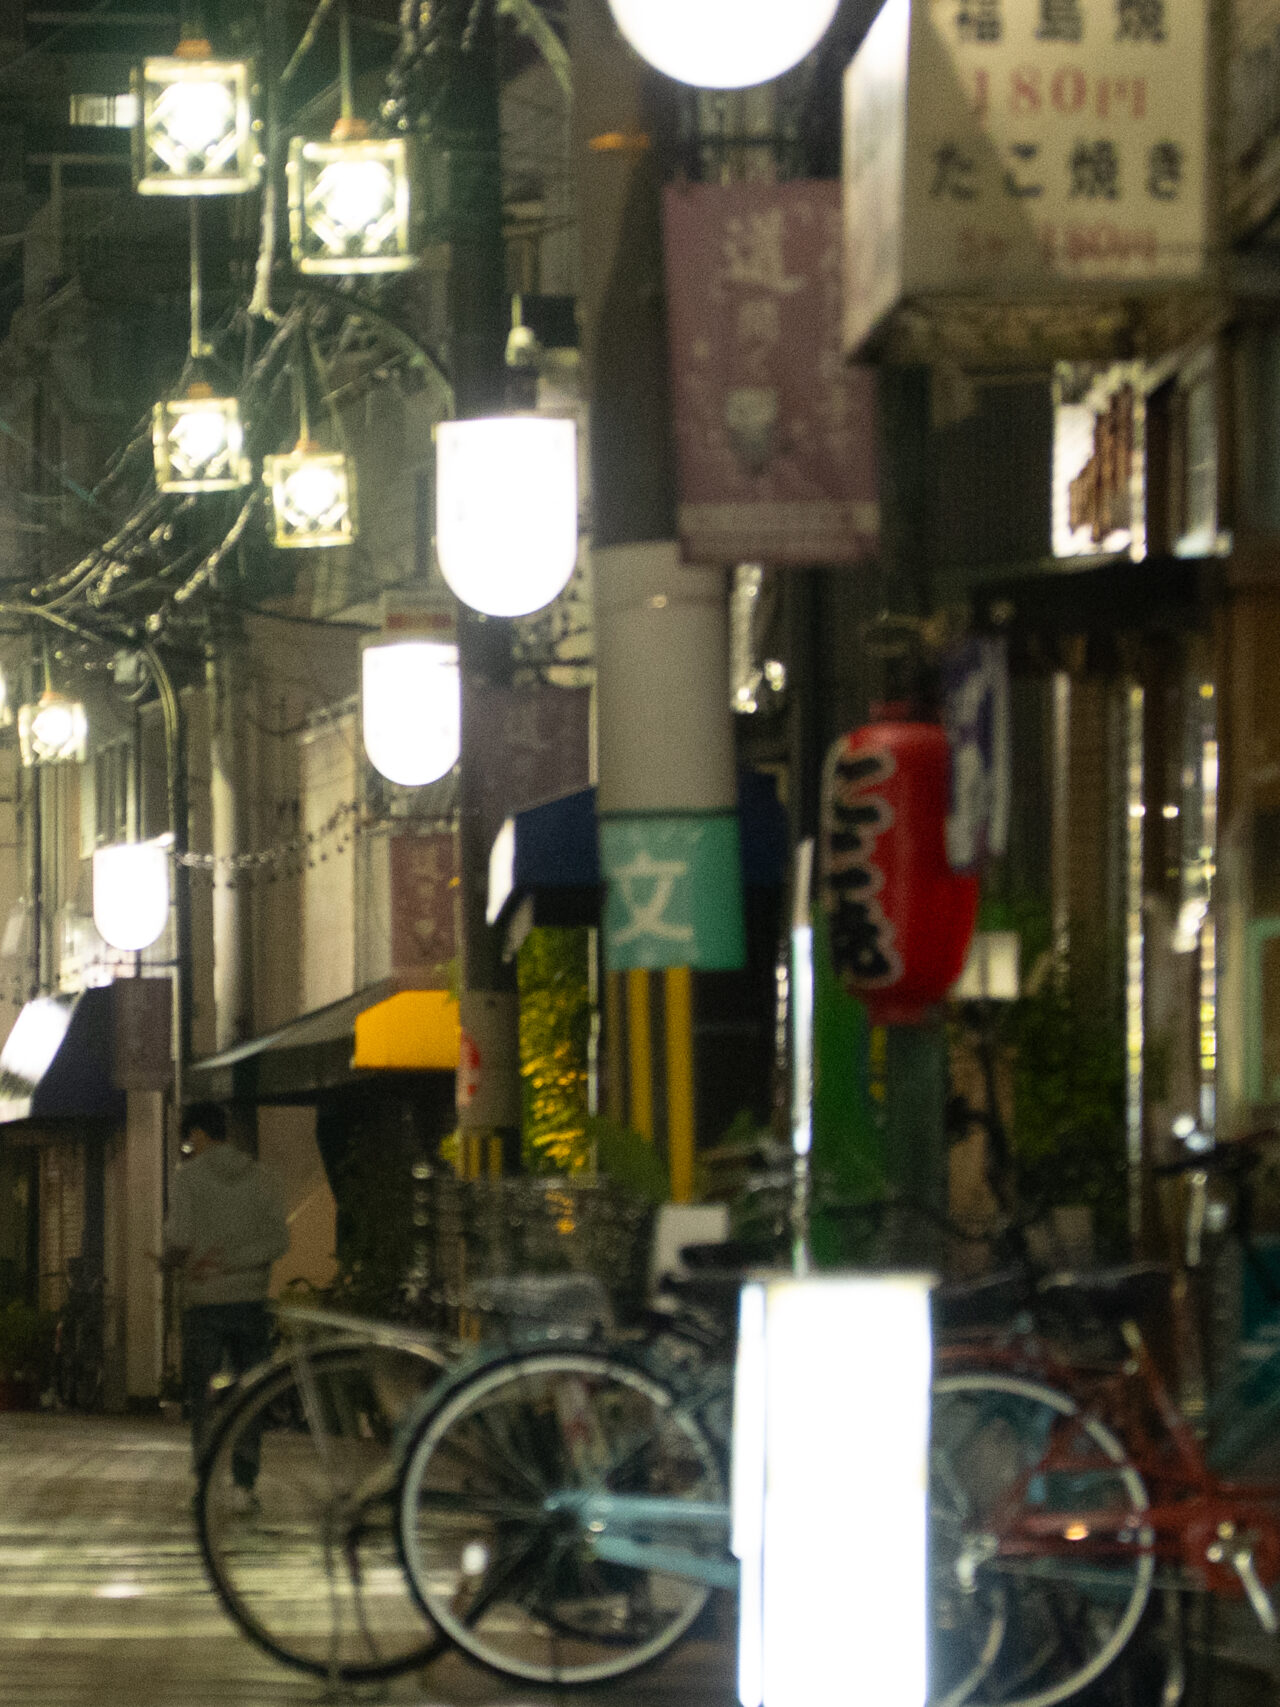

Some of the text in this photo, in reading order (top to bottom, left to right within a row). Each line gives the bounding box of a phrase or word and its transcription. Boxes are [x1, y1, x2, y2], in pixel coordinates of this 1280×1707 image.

[928, 139, 1181, 199] たこ焼き
[609, 850, 695, 946] 文
